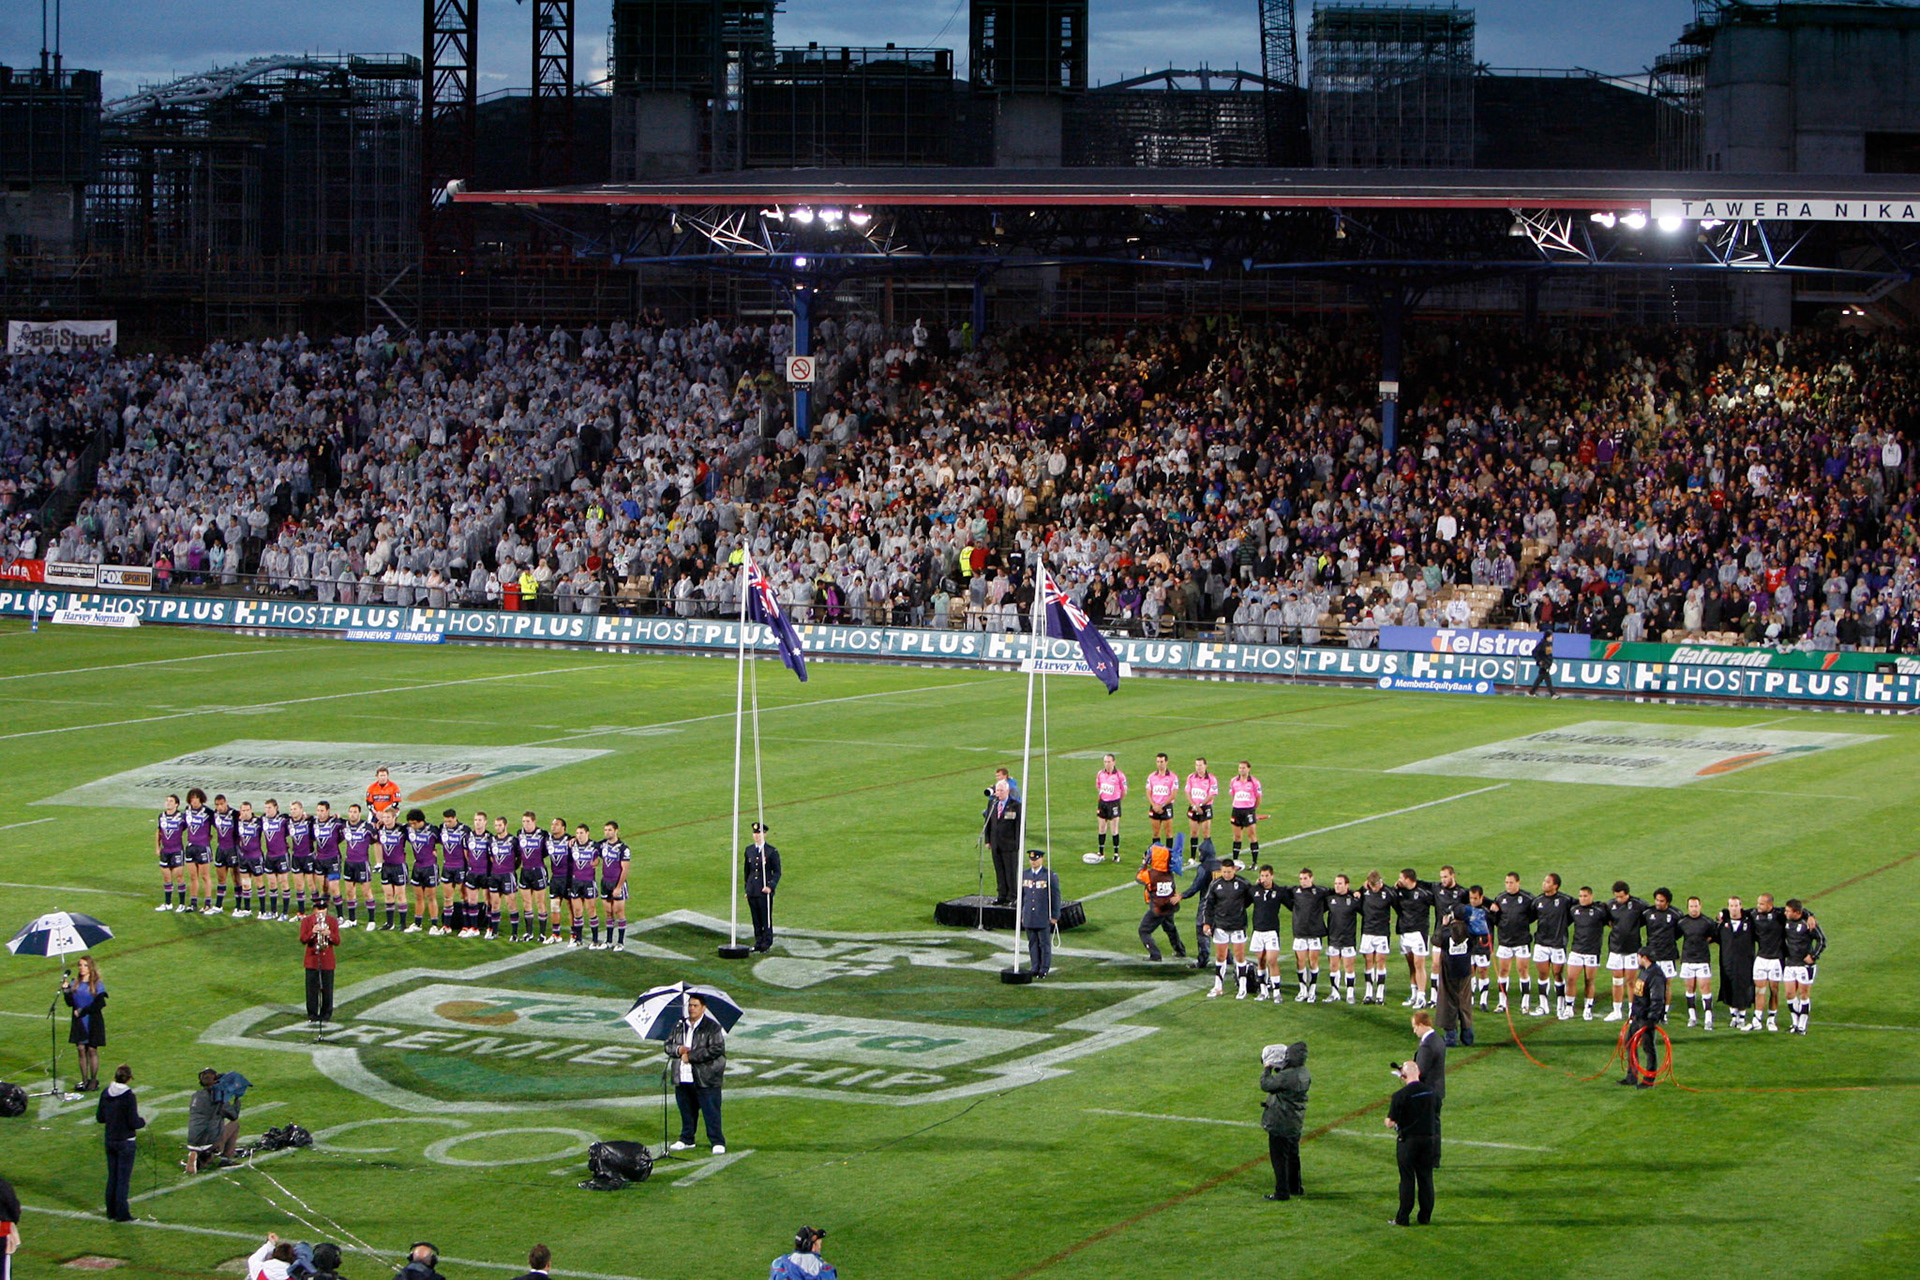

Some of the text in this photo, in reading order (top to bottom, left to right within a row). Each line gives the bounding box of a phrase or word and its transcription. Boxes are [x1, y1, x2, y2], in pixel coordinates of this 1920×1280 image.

[1682, 201, 1915, 219] TAWERA NIKA
[100, 570, 148, 584] FOX SPORTS
[63, 611, 126, 623] Harvey Norman
[102, 597, 225, 620] HOSTPLUS
[272, 604, 400, 628] HOSTPLUS
[449, 612, 584, 637] HOSTPLUS
[636, 617, 776, 646] HOSTPLUS
[830, 629, 975, 655] HOSTPLUS
[1436, 629, 1537, 656] Telstra
[1034, 660, 1071, 673] Harvey
[1241, 648, 1398, 675] HOSTPLUS
[1670, 646, 1773, 668] Gatorade
[1684, 668, 1850, 697] HOSTPLUS
